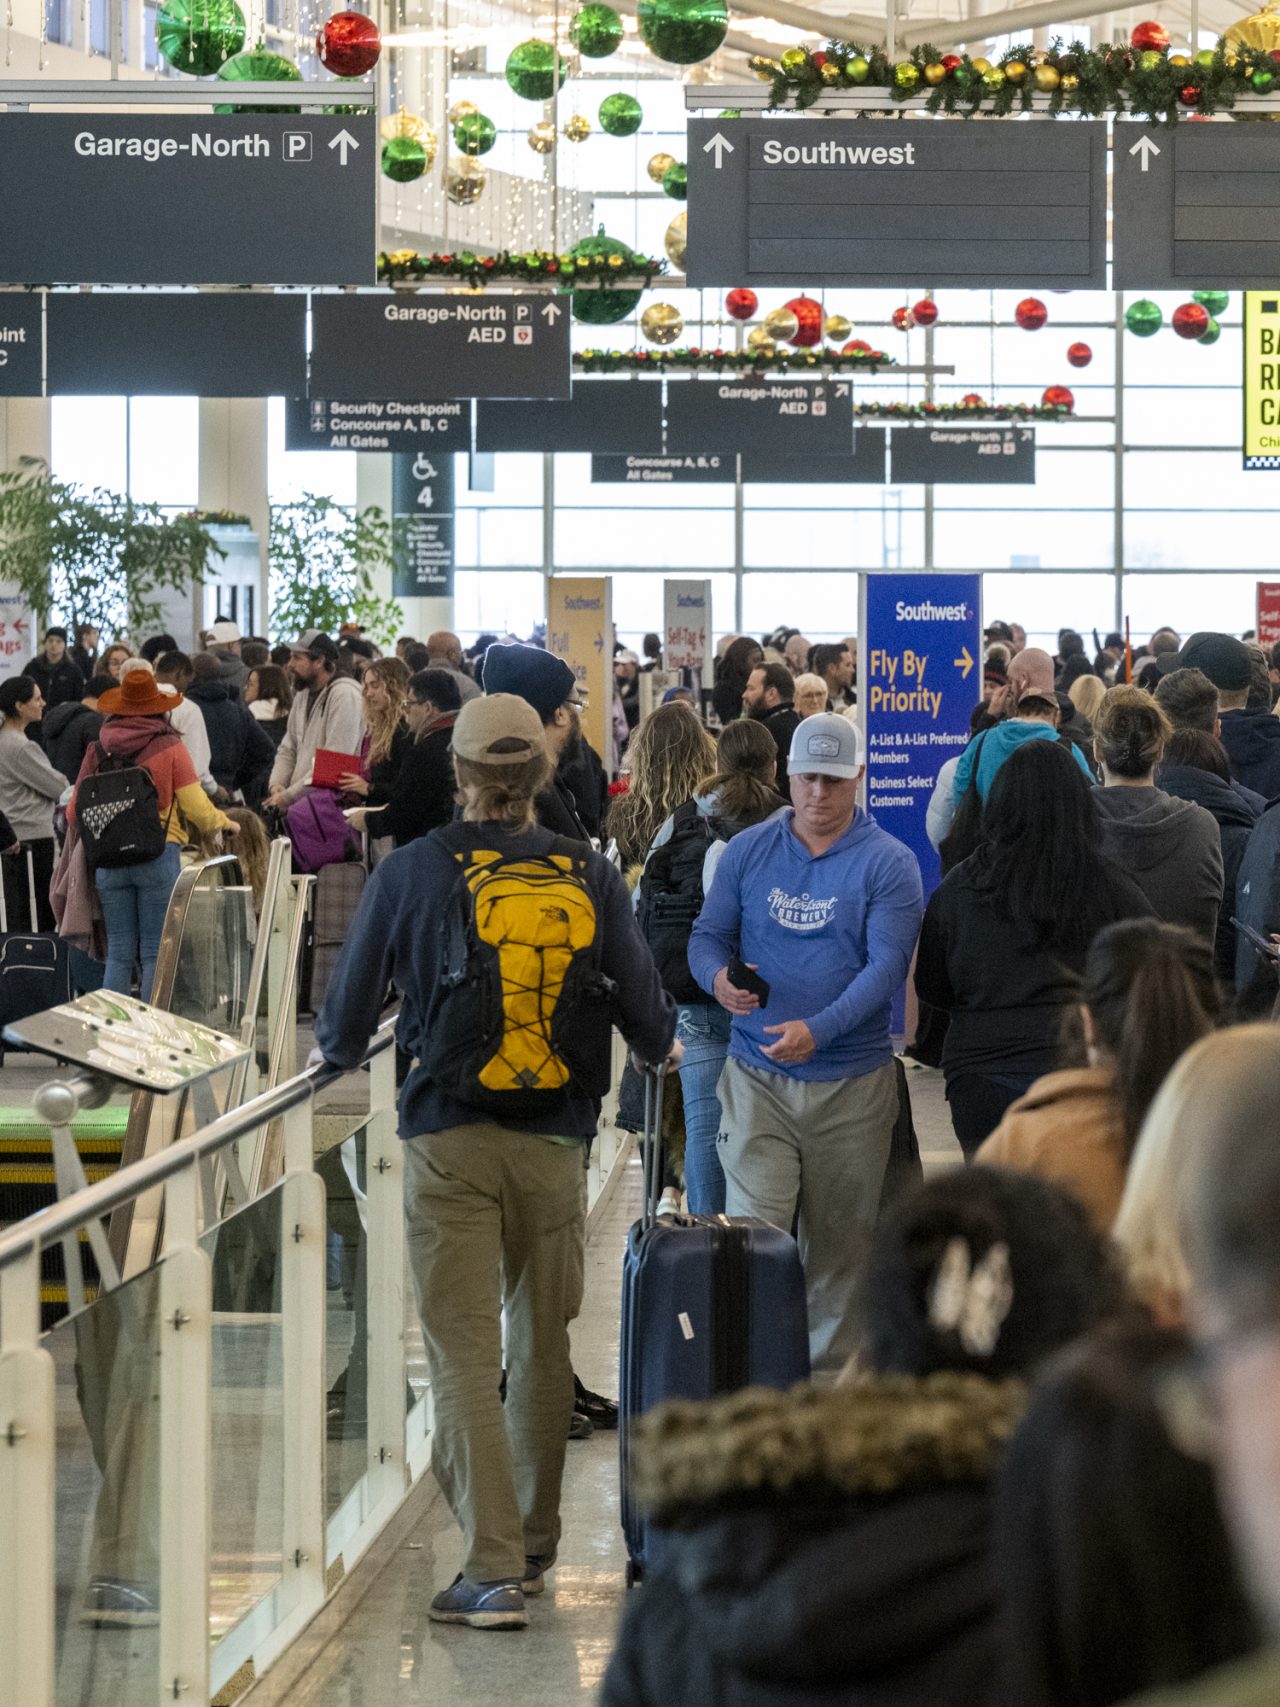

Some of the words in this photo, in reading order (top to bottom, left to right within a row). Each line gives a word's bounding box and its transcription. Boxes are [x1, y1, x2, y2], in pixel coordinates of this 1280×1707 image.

[74, 131, 270, 162] Garage-North
[763, 140, 915, 165] Southwest
[384, 304, 506, 324] Garage-North
[467, 327, 506, 343] AED
[718, 386, 808, 401] Garage-North
[330, 401, 384, 417] Security
[386, 401, 461, 417] Checkpoint
[778, 401, 808, 415] AED
[330, 418, 401, 431] Concourse
[403, 418, 418, 433] A,
[420, 418, 435, 433] B,
[437, 418, 449, 431] C
[330, 434, 347, 448] All
[351, 434, 389, 448] Gates
[417, 486, 434, 508] 4
[895, 600, 968, 621] Southwest
[870, 649, 898, 684] Fly
[903, 649, 928, 684] By
[870, 685, 943, 719] Priority
[870, 733, 895, 746] A-List
[903, 733, 928, 746] A-List
[929, 732, 968, 745] Preferred
[869, 751, 909, 764] Members
[870, 776, 906, 789] Business
[907, 775, 933, 788] Select
[869, 795, 914, 807] Customers
[777, 907, 827, 923] BREWERY
